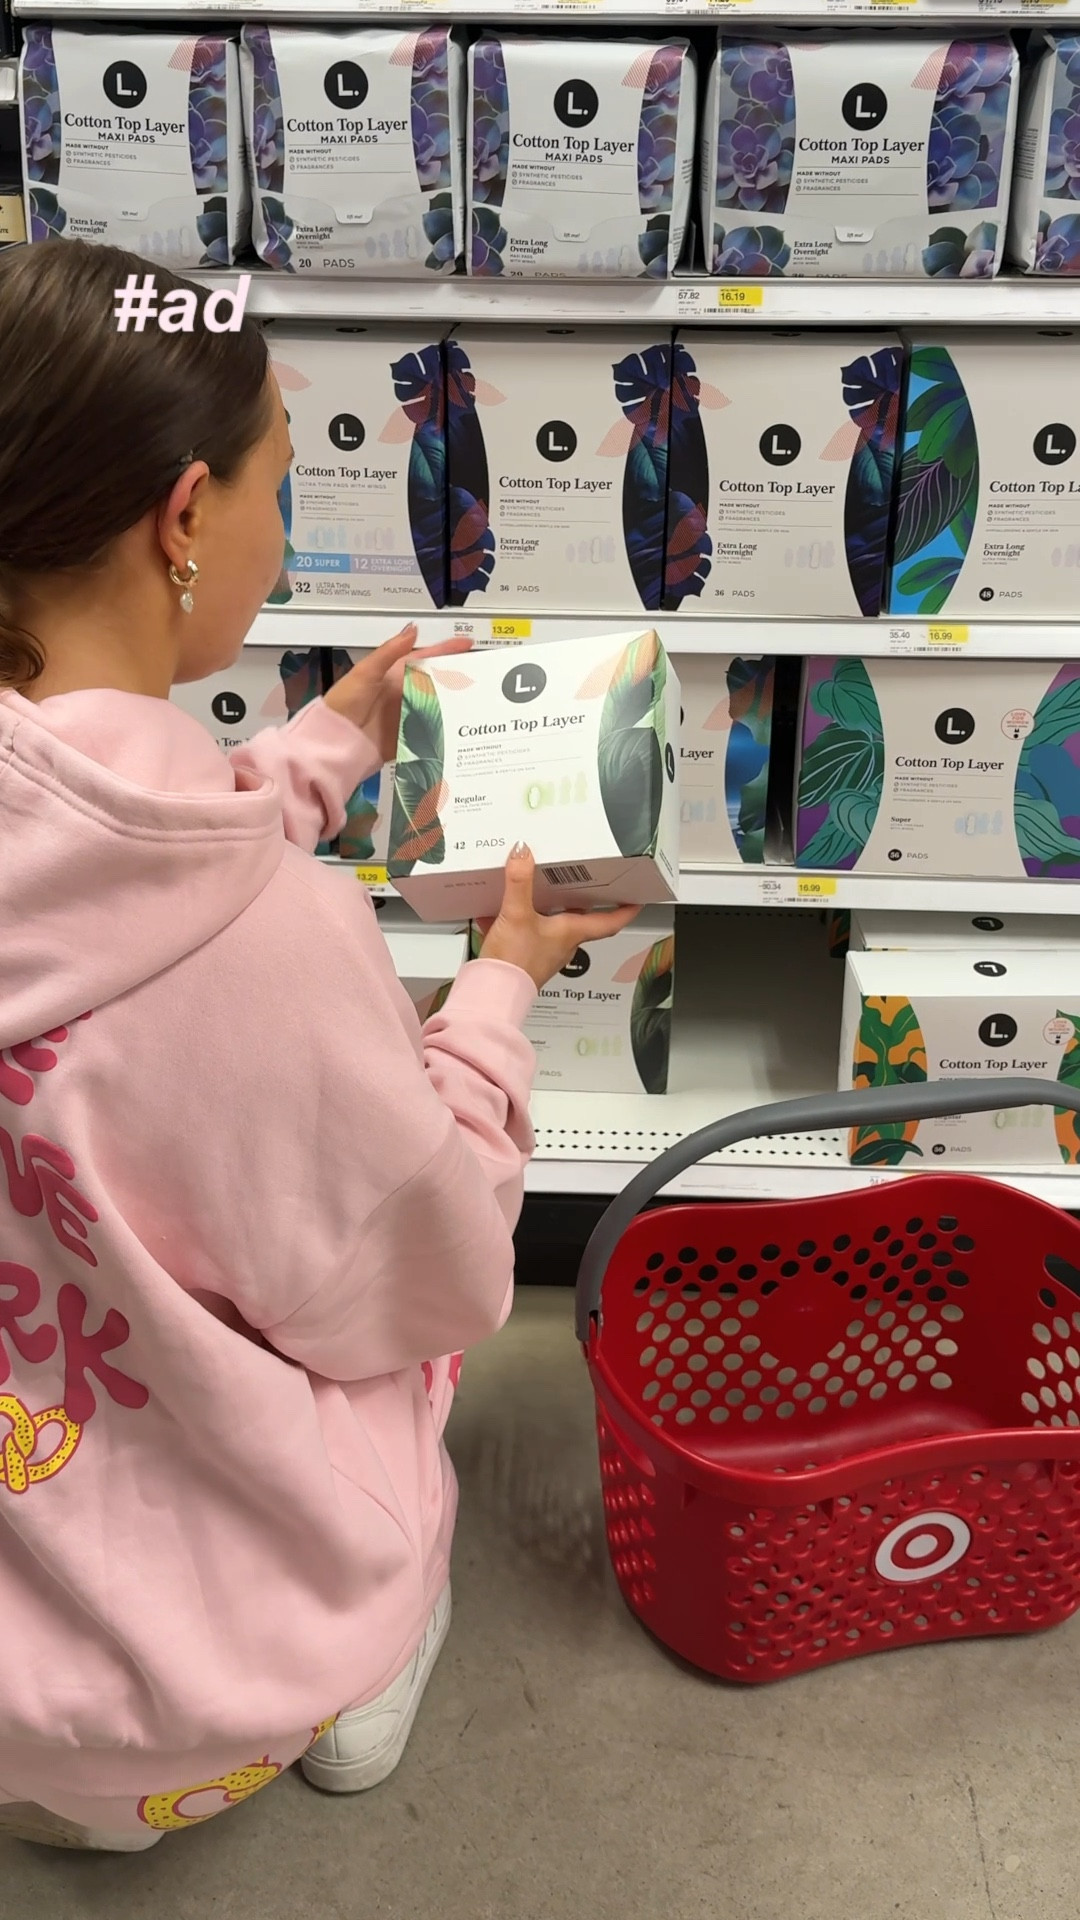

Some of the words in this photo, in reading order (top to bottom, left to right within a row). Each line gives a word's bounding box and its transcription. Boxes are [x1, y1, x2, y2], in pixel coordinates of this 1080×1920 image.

[116, 73, 138, 96] L.
[337, 73, 360, 96] L.
[568, 92, 588, 116] L.
[856, 95, 877, 118] L.
[64, 113, 112, 129] Cotton
[115, 116, 141, 133] Top
[145, 118, 185, 136] Layer
[287, 119, 333, 132] Cotton
[337, 118, 364, 134] Top
[368, 118, 408, 134] Layer
[98, 132, 125, 142] MAXI
[128, 134, 155, 144] PADS
[321, 135, 347, 144] MAXI
[350, 135, 378, 144] PADS
[513, 134, 559, 148] Cotton
[564, 136, 590, 153] Top
[594, 138, 634, 154] Layer
[799, 138, 846, 151] Cotton
[852, 138, 878, 154] Top
[884, 138, 925, 154] Layer
[546, 153, 572, 162] MAXI
[575, 154, 603, 162] PADS
[832, 156, 858, 164] MAXI
[862, 156, 890, 164] PADS
[70, 226, 105, 234] Overnight
[90, 219, 108, 227] Long
[315, 226, 333, 234] Long
[510, 246, 544, 254] Overnight
[530, 239, 548, 248] Long
[814, 241, 832, 249] Long
[299, 258, 312, 268] 20
[324, 258, 355, 268] PADS
[720, 292, 745, 300] 16.19
[339, 423, 358, 442] L.
[548, 432, 568, 451] L.
[772, 435, 792, 455] L.
[1046, 434, 1066, 454] L.
[296, 465, 336, 477] Cotton
[338, 466, 361, 480] Top
[364, 468, 398, 481] Layer
[499, 476, 542, 490] Cotton
[546, 478, 571, 492] Top
[574, 478, 612, 492] Layer
[720, 480, 764, 492] Cotton
[768, 482, 792, 496] Top
[797, 482, 835, 496] Layer
[990, 480, 1035, 492] Cotton
[1039, 481, 1064, 496] Top
[521, 538, 539, 546] Long
[296, 556, 312, 568] 20
[354, 558, 369, 570] 12
[296, 582, 311, 593] 32
[515, 674, 536, 693] L.
[222, 700, 239, 716] L.
[458, 723, 506, 738] Cotton
[510, 718, 538, 732] Top
[542, 714, 586, 728] Layer
[946, 717, 966, 734] L.
[680, 748, 714, 760] Layer
[895, 756, 936, 768] Cotton
[941, 758, 964, 770] Top
[968, 758, 1004, 772] Layer
[454, 795, 486, 804] Regular
[454, 842, 466, 850] 42
[476, 838, 506, 848] PADS
[563, 989, 584, 1000] Top
[588, 990, 621, 1002] Layer
[990, 1022, 1008, 1038] L.
[939, 1059, 981, 1069] Cotton
[984, 1059, 1008, 1070] Top
[1012, 1060, 1048, 1071] Layer
